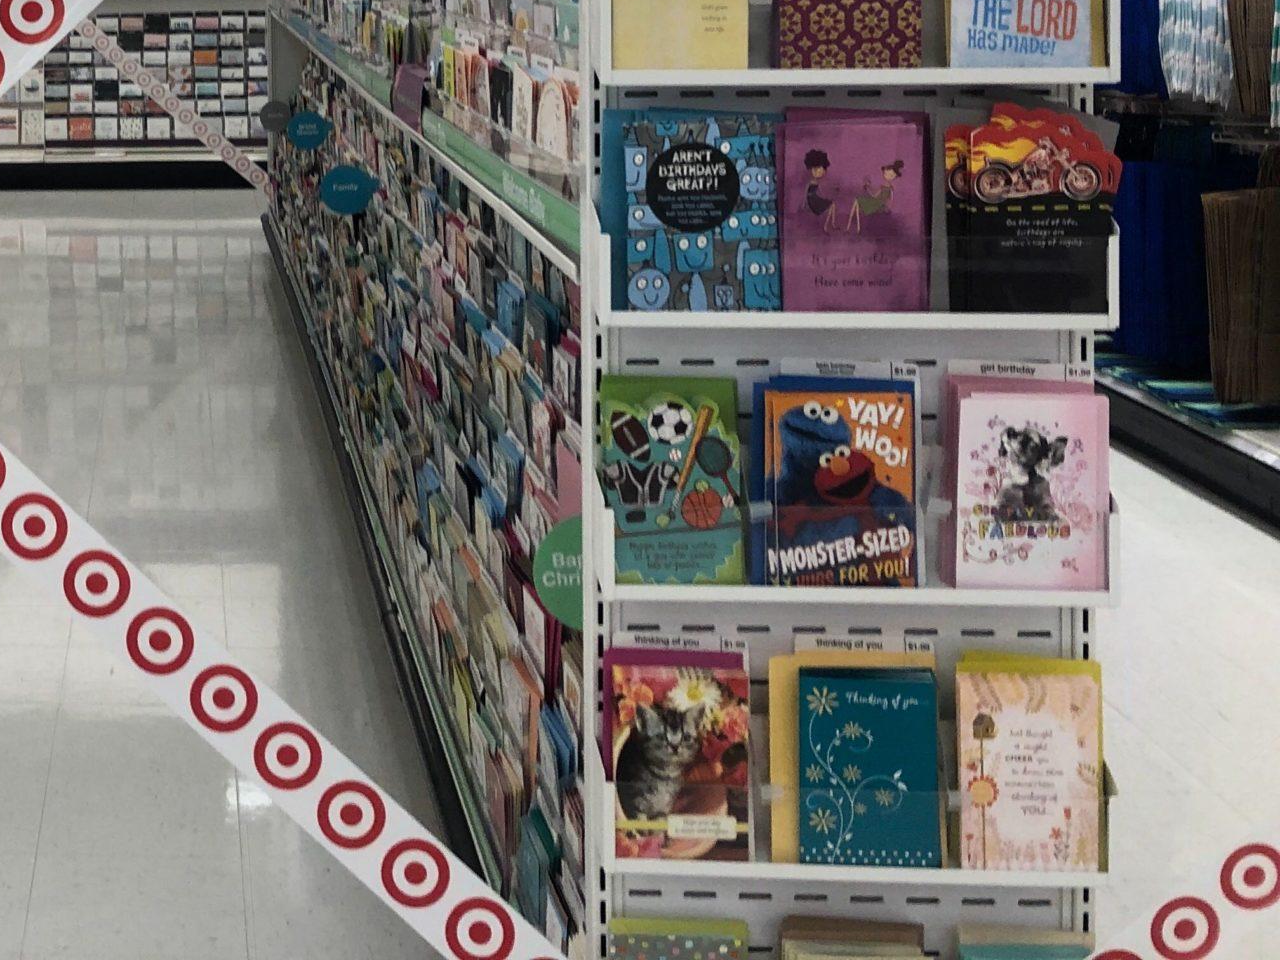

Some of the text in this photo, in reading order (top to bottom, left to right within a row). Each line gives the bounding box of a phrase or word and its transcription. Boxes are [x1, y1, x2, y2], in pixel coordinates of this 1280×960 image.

[672, 150, 712, 163] AREN'T
[658, 163, 726, 177] BIRTHDAYS
[333, 183, 358, 193] Family
[667, 178, 718, 191] GREAT?!
[1051, 218, 1060, 227] of
[980, 364, 1035, 375] girl birthday
[848, 397, 904, 429] YAY!
[855, 426, 908, 467] WOO!
[779, 525, 910, 575] MONSTER-SIZED
[839, 562, 869, 583] FOR
[874, 556, 910, 579] YOU!
[634, 635, 700, 649] thinking of you
[855, 639, 864, 649] of
[866, 641, 883, 651] you
[845, 691, 919, 710] Thinking of you
